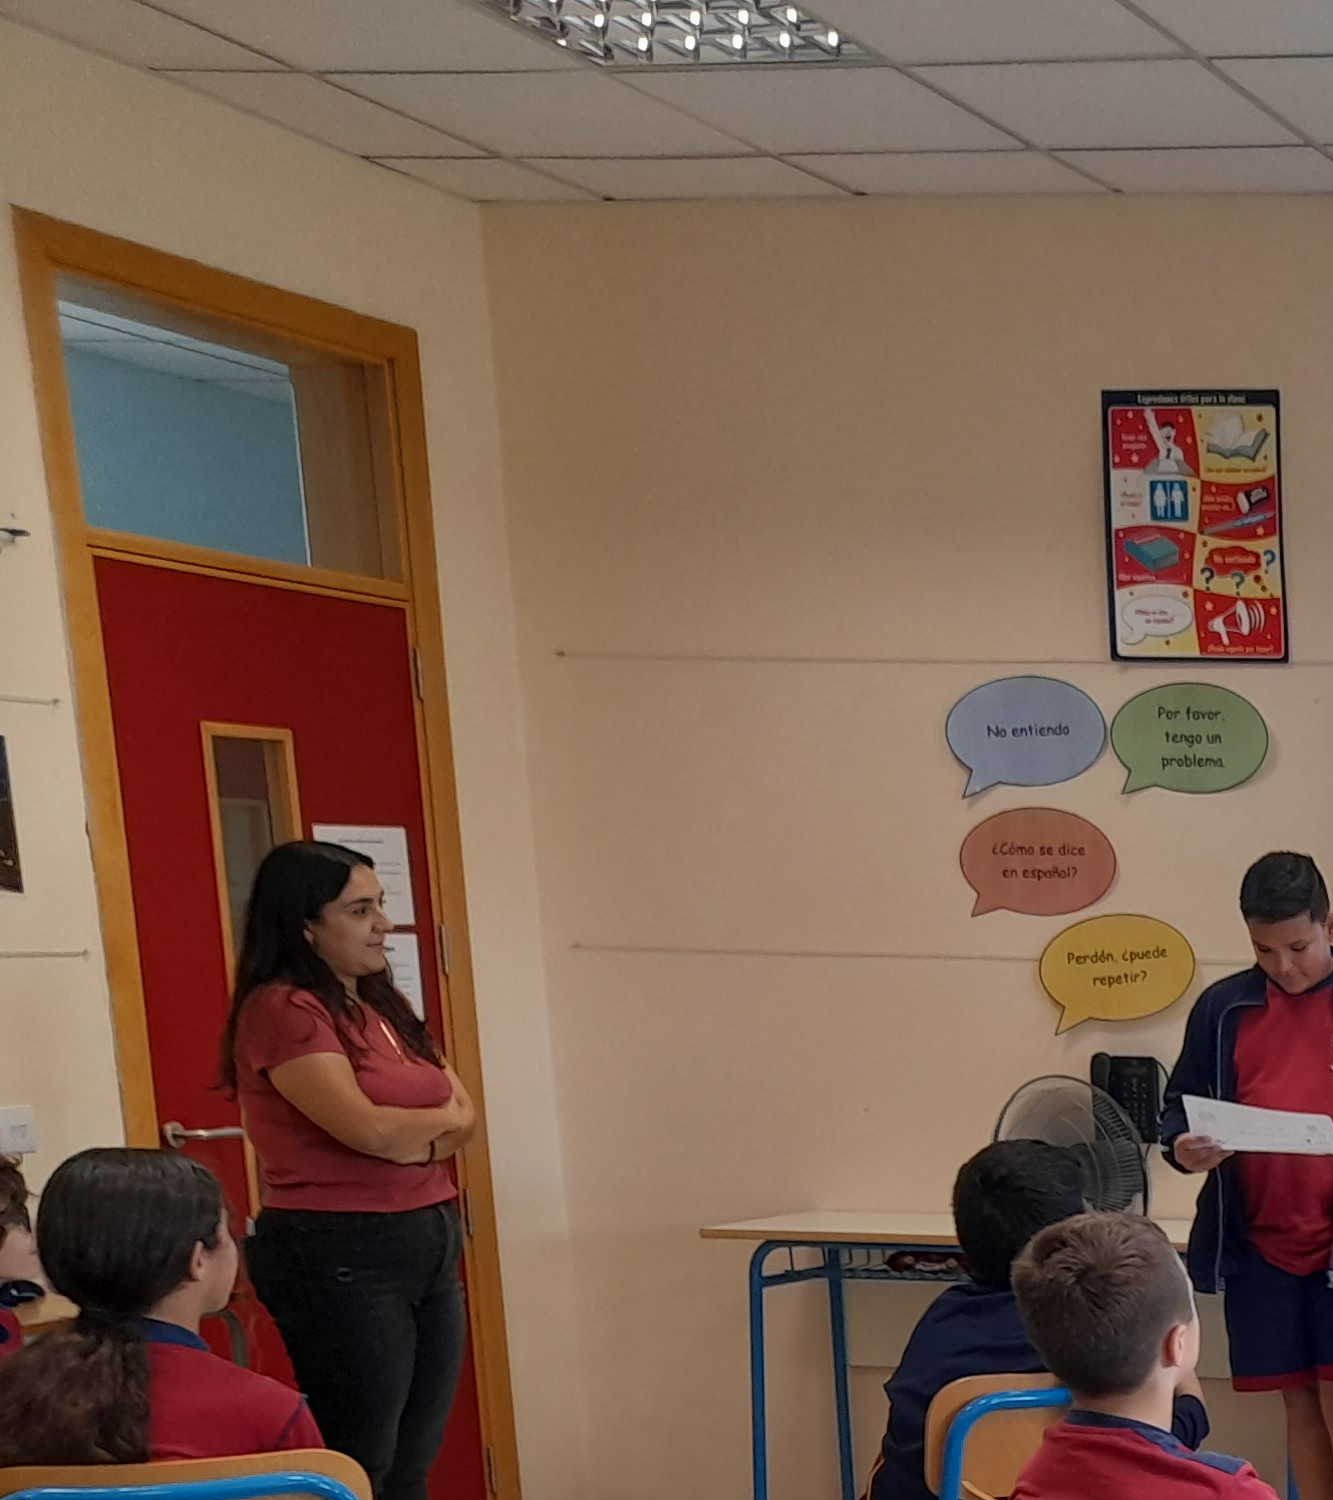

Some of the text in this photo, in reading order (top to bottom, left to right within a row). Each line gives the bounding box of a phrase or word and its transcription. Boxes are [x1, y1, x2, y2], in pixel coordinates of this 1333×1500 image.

[1158, 706, 1180, 720] Por
[987, 724, 1070, 738] No entiendo
[1165, 731, 1222, 748] tengo un
[992, 842, 1085, 856] ¿Cómo se dice
[1002, 866, 1078, 881] en español?
[1121, 947, 1168, 964] ¿puede
[1092, 970, 1148, 988] repetir?
